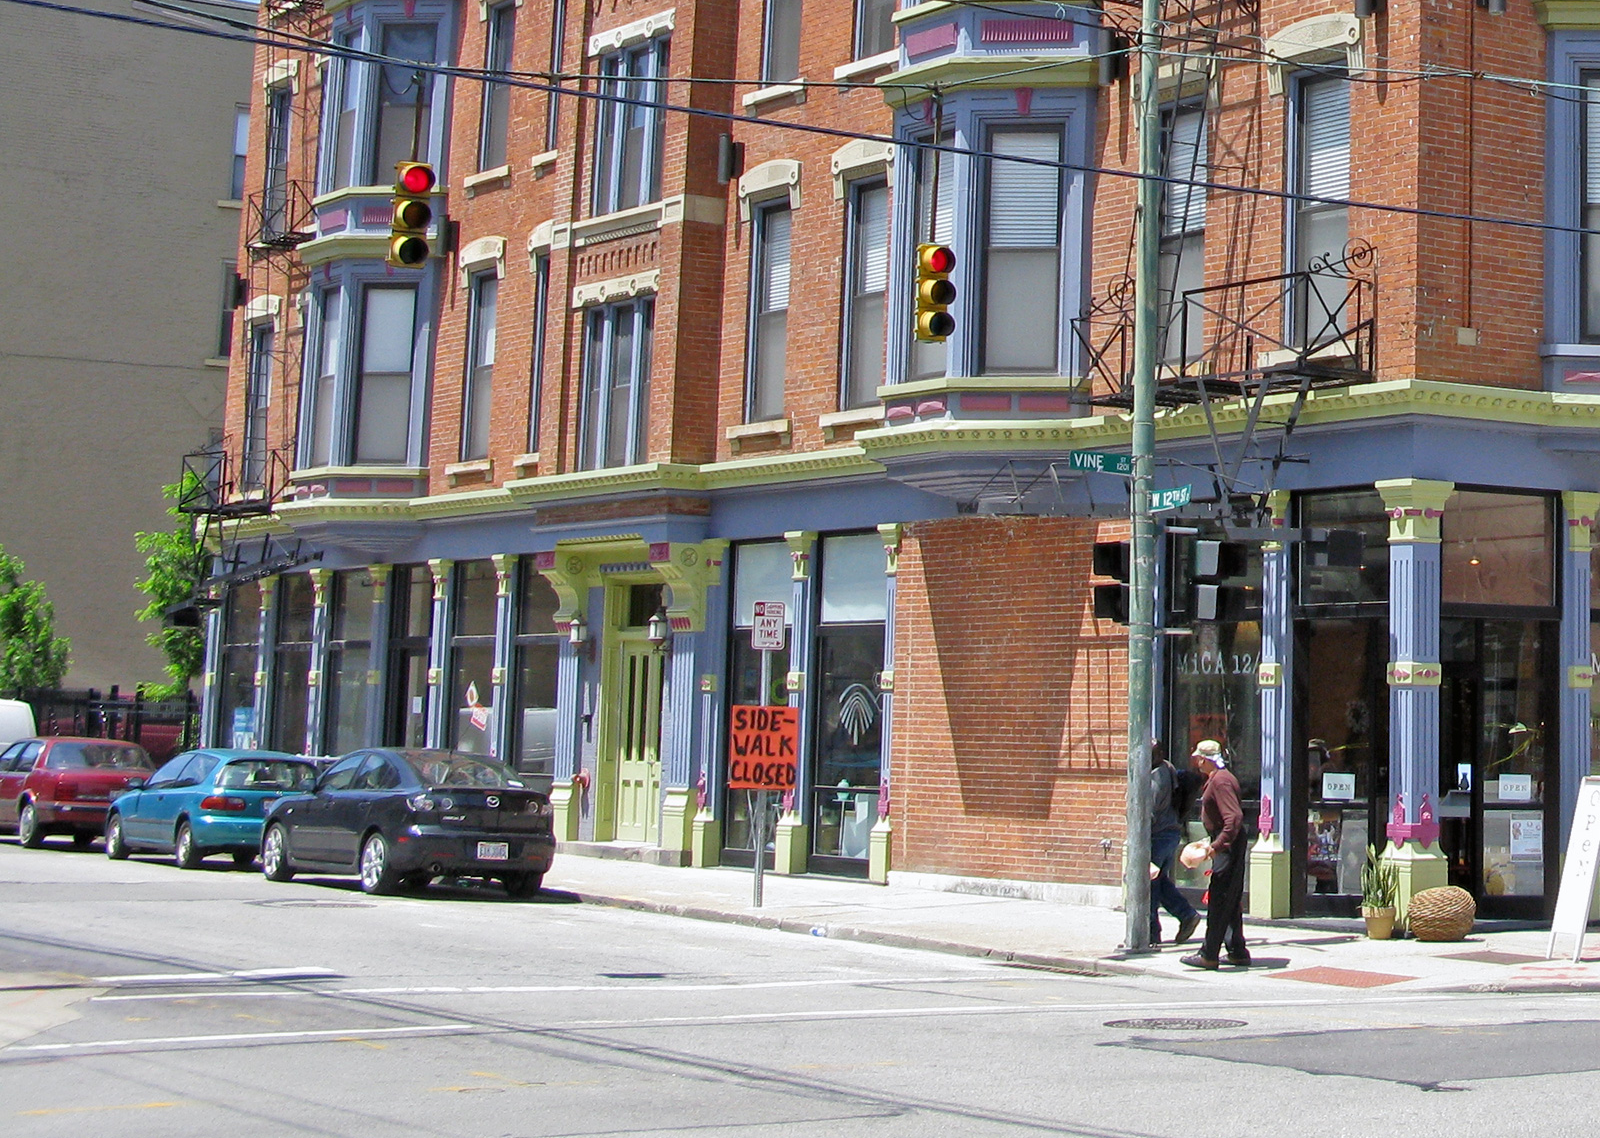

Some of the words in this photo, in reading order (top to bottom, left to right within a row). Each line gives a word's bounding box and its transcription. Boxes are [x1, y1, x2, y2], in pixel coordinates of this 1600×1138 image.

[1073, 452, 1104, 468] VINE
[1116, 463, 1130, 471] 1201
[1152, 493, 1160, 507] W
[1163, 490, 1180, 506] 12TH
[755, 604, 764, 614] NO
[760, 619, 778, 627] ANY
[759, 630, 778, 639] TIME
[1232, 650, 1260, 674] 12/
[734, 708, 796, 731] SIDE-
[733, 734, 794, 757] WALK
[731, 760, 796, 785] CLOSED
[1327, 783, 1351, 791] OPEN
[1503, 784, 1528, 792] OPEN
